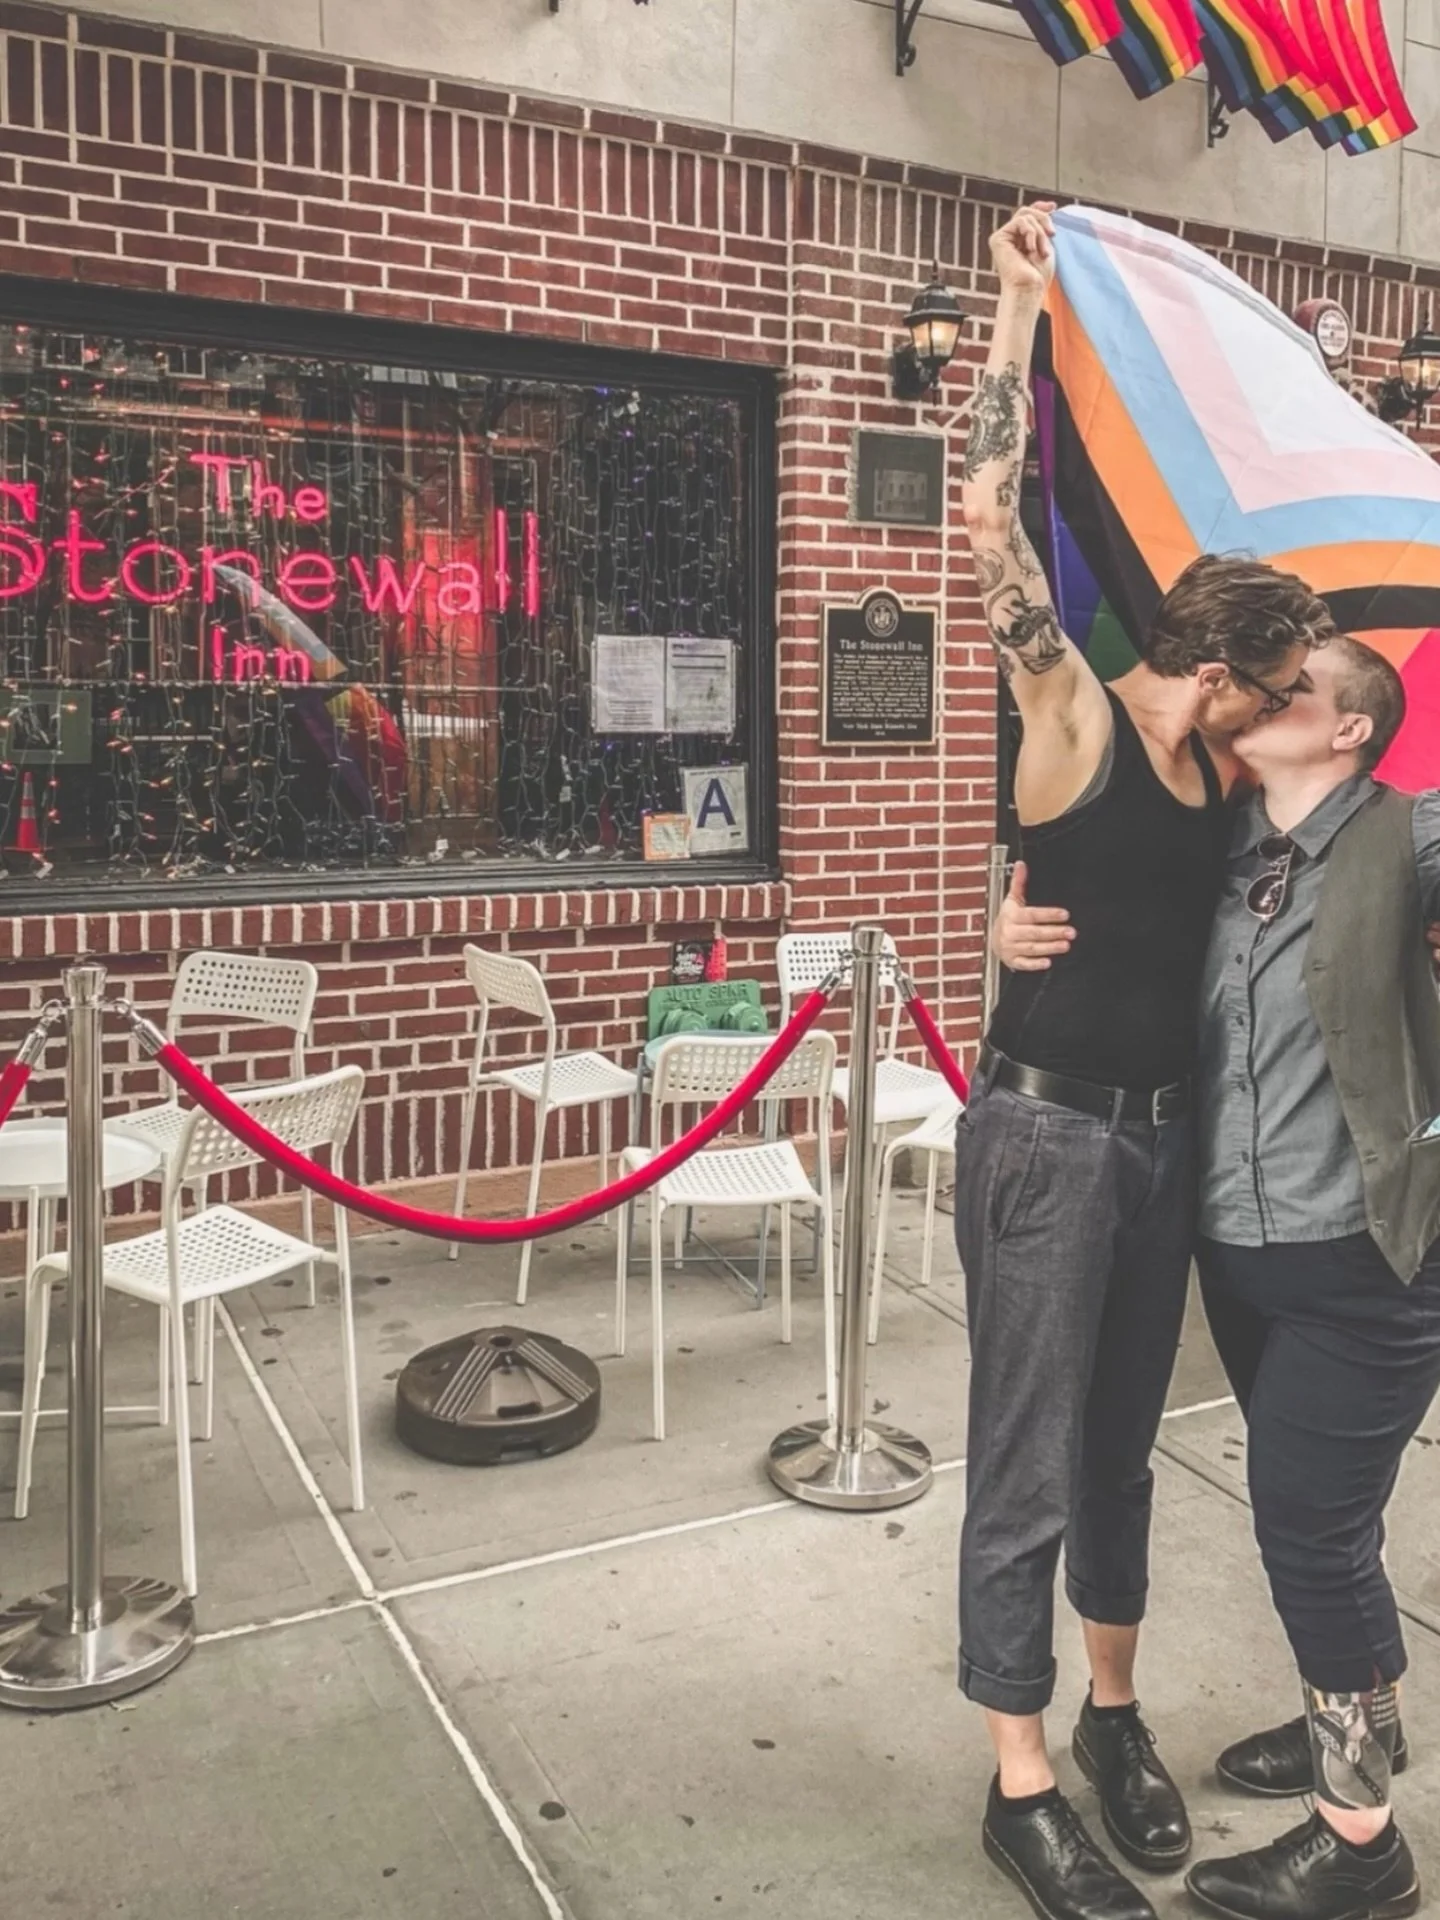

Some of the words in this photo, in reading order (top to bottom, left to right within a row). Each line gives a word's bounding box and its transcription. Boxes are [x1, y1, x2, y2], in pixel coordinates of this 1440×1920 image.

[189, 453, 328, 522] The
[0, 480, 541, 618] Stonewall
[212, 624, 311, 684] Inn
[840, 638, 857, 651] The
[860, 639, 905, 652] Stonewall
[907, 640, 923, 651] Inn
[697, 777, 737, 829] A
[665, 987, 702, 1001] AUTO
